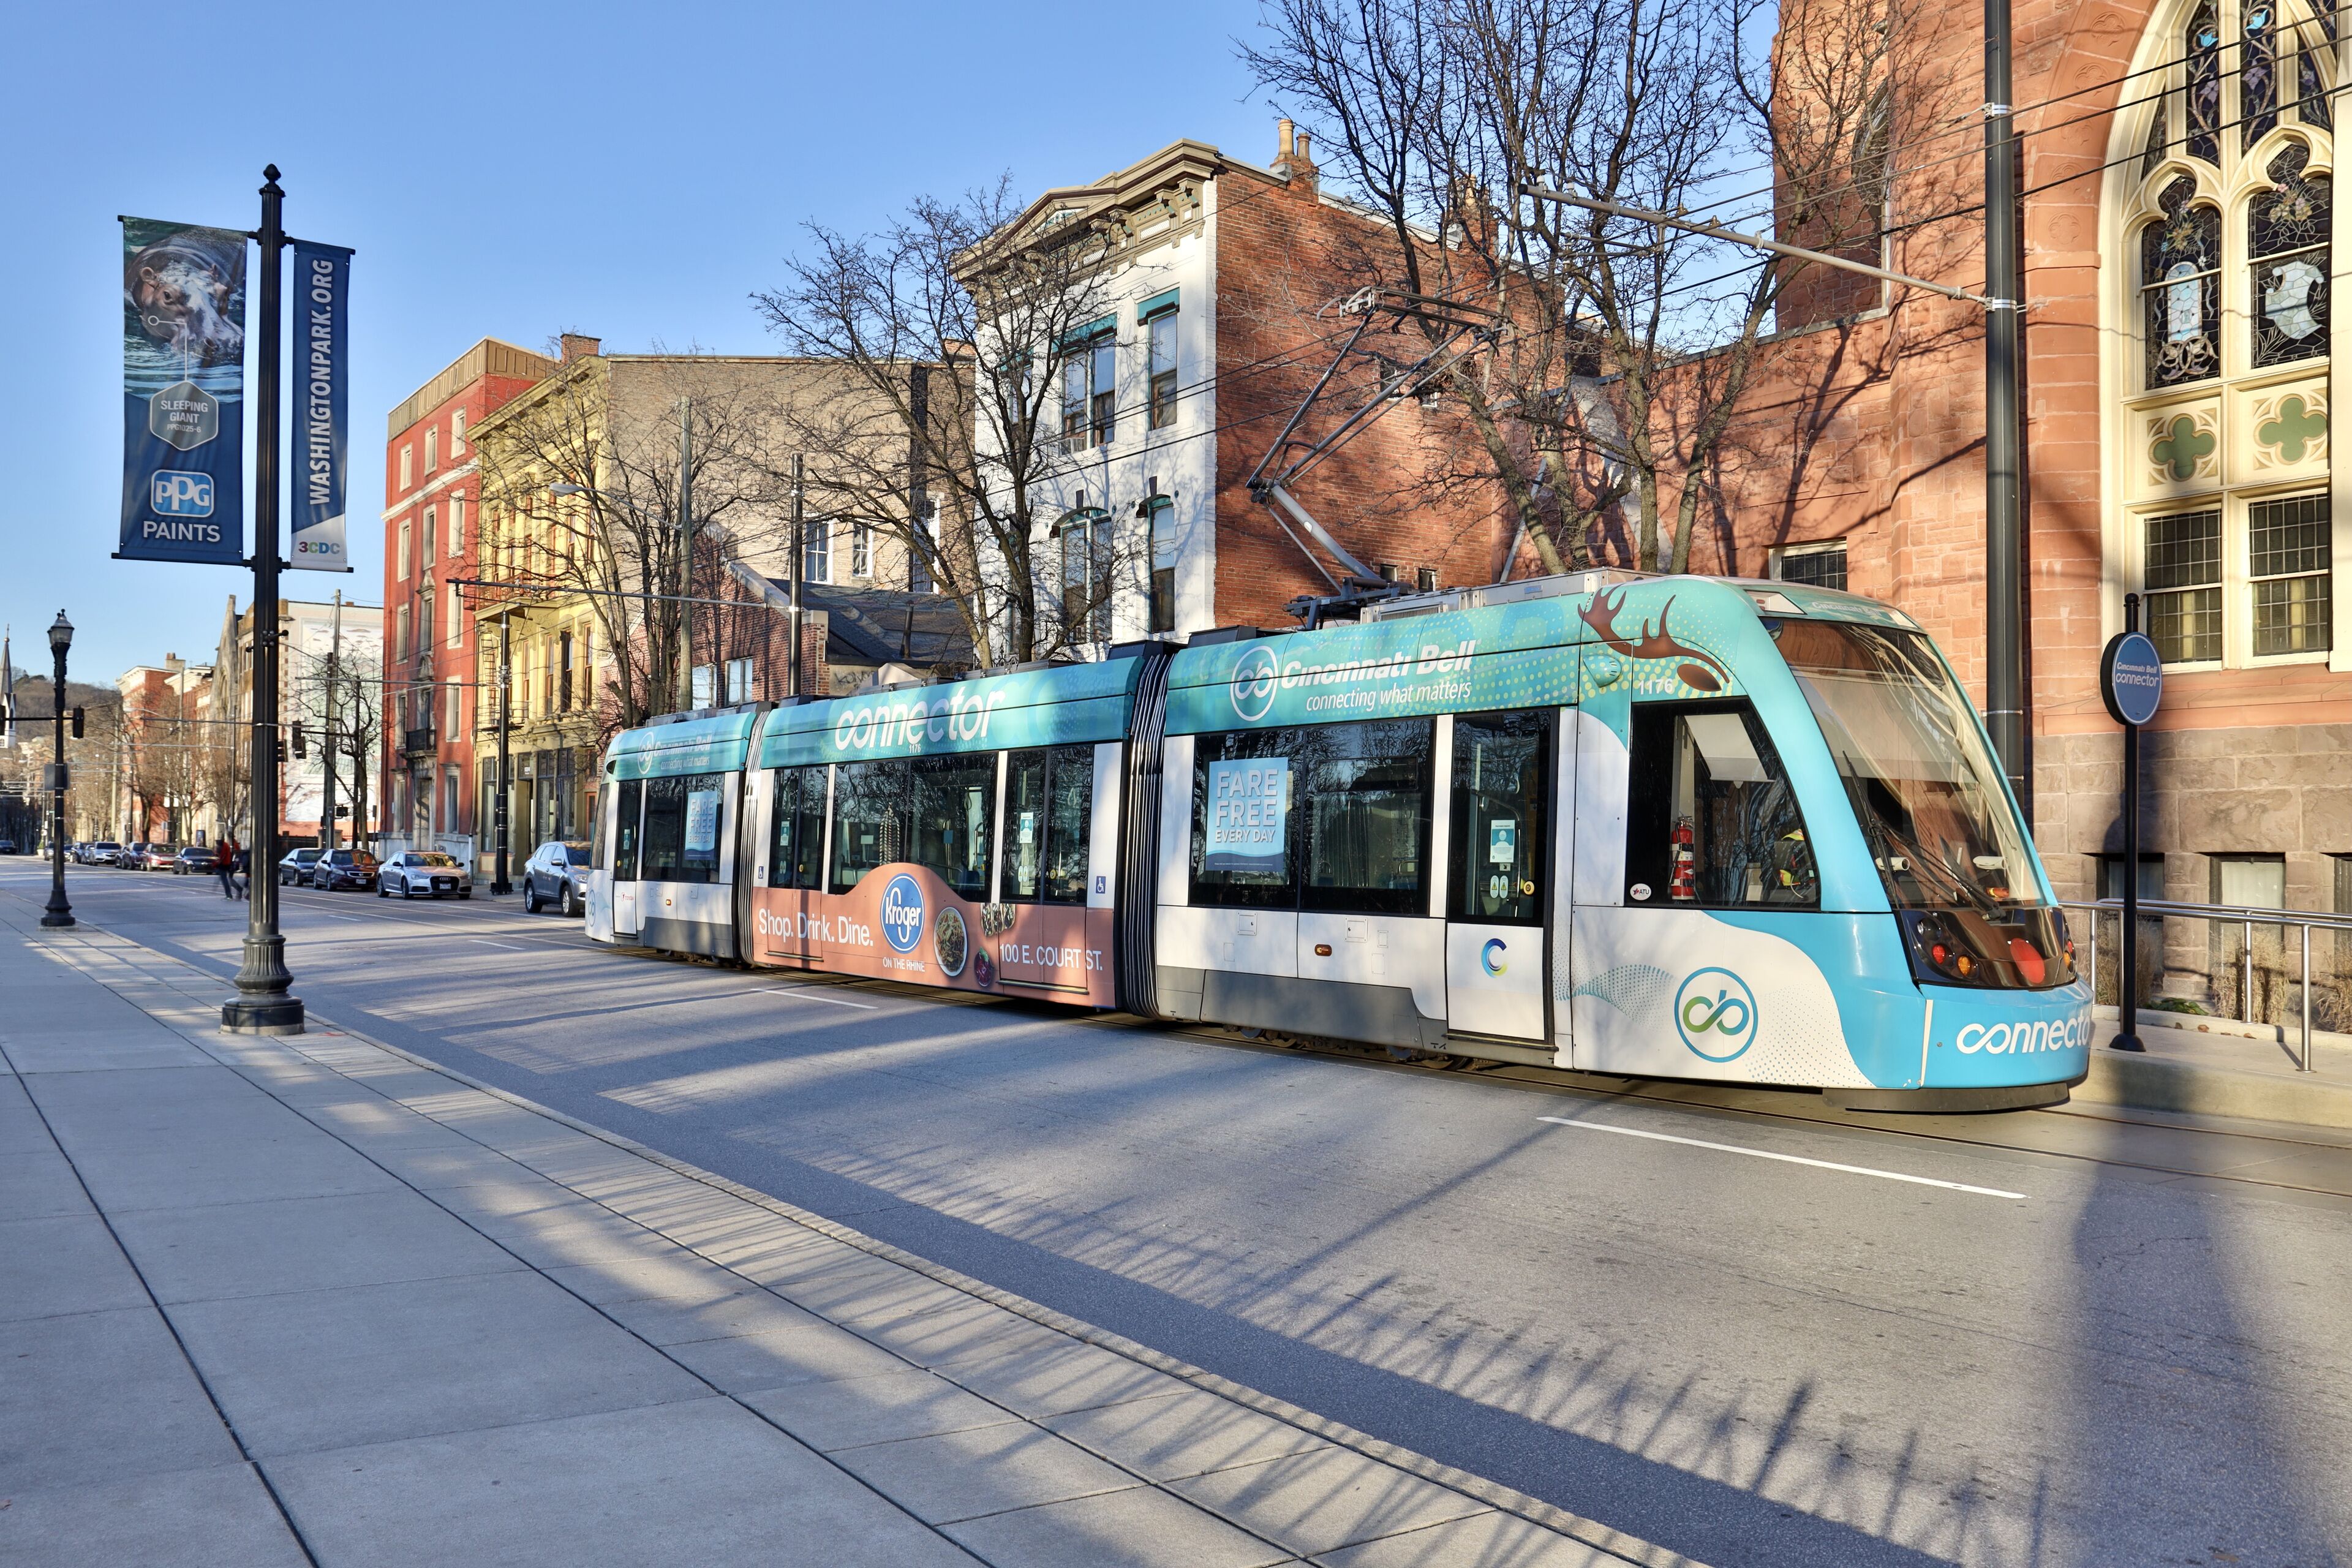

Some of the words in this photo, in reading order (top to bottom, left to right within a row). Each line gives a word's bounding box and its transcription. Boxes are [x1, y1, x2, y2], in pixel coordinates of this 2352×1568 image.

[309, 259, 333, 505] WASHINGTONPARK.ORG
[160, 400, 208, 412] SLEEPING
[170, 412, 200, 423] GIANT
[167, 424, 202, 433] PPG1025-6
[156, 475, 209, 511] PPG
[143, 521, 221, 542] PAINTS
[298, 541, 341, 554] 3CDC
[1281, 651, 1410, 689] Cincinnati
[1415, 639, 1476, 675] Bell
[2117, 662, 2145, 673] Cincinnati
[2146, 665, 2158, 674] Bell
[1638, 678, 1675, 695] 1176
[2116, 673, 2160, 687] connector
[1306, 687, 1376, 712] connecting
[1379, 682, 1414, 705] what
[1416, 679, 1472, 701] matters
[835, 686, 1006, 751] connector
[654, 739, 693, 757] Cincinnati
[909, 744, 921, 754] 1176
[661, 758, 683, 771] connecting
[683, 755, 693, 767] what
[693, 755, 710, 766] matters
[1217, 769, 1279, 798] FARE
[690, 797, 714, 816] FARE
[1216, 799, 1277, 827] FREE
[689, 816, 713, 834] FREE
[688, 834, 703, 843] EVERY
[703, 834, 712, 843] DAY
[1215, 829, 1250, 843] EVERY
[1253, 829, 1275, 843] DAY
[885, 887, 922, 943] Kroger
[758, 908, 794, 943] Shop.
[797, 912, 835, 942] Drink.
[838, 916, 873, 946] Dine.
[883, 957, 892, 968] ON
[892, 958, 905, 970] THE
[906, 960, 925, 972] RHINE
[1000, 943, 1019, 963] 100
[1022, 944, 1034, 965] E.
[1036, 946, 1081, 968] COURT
[1085, 949, 1103, 971] ST.
